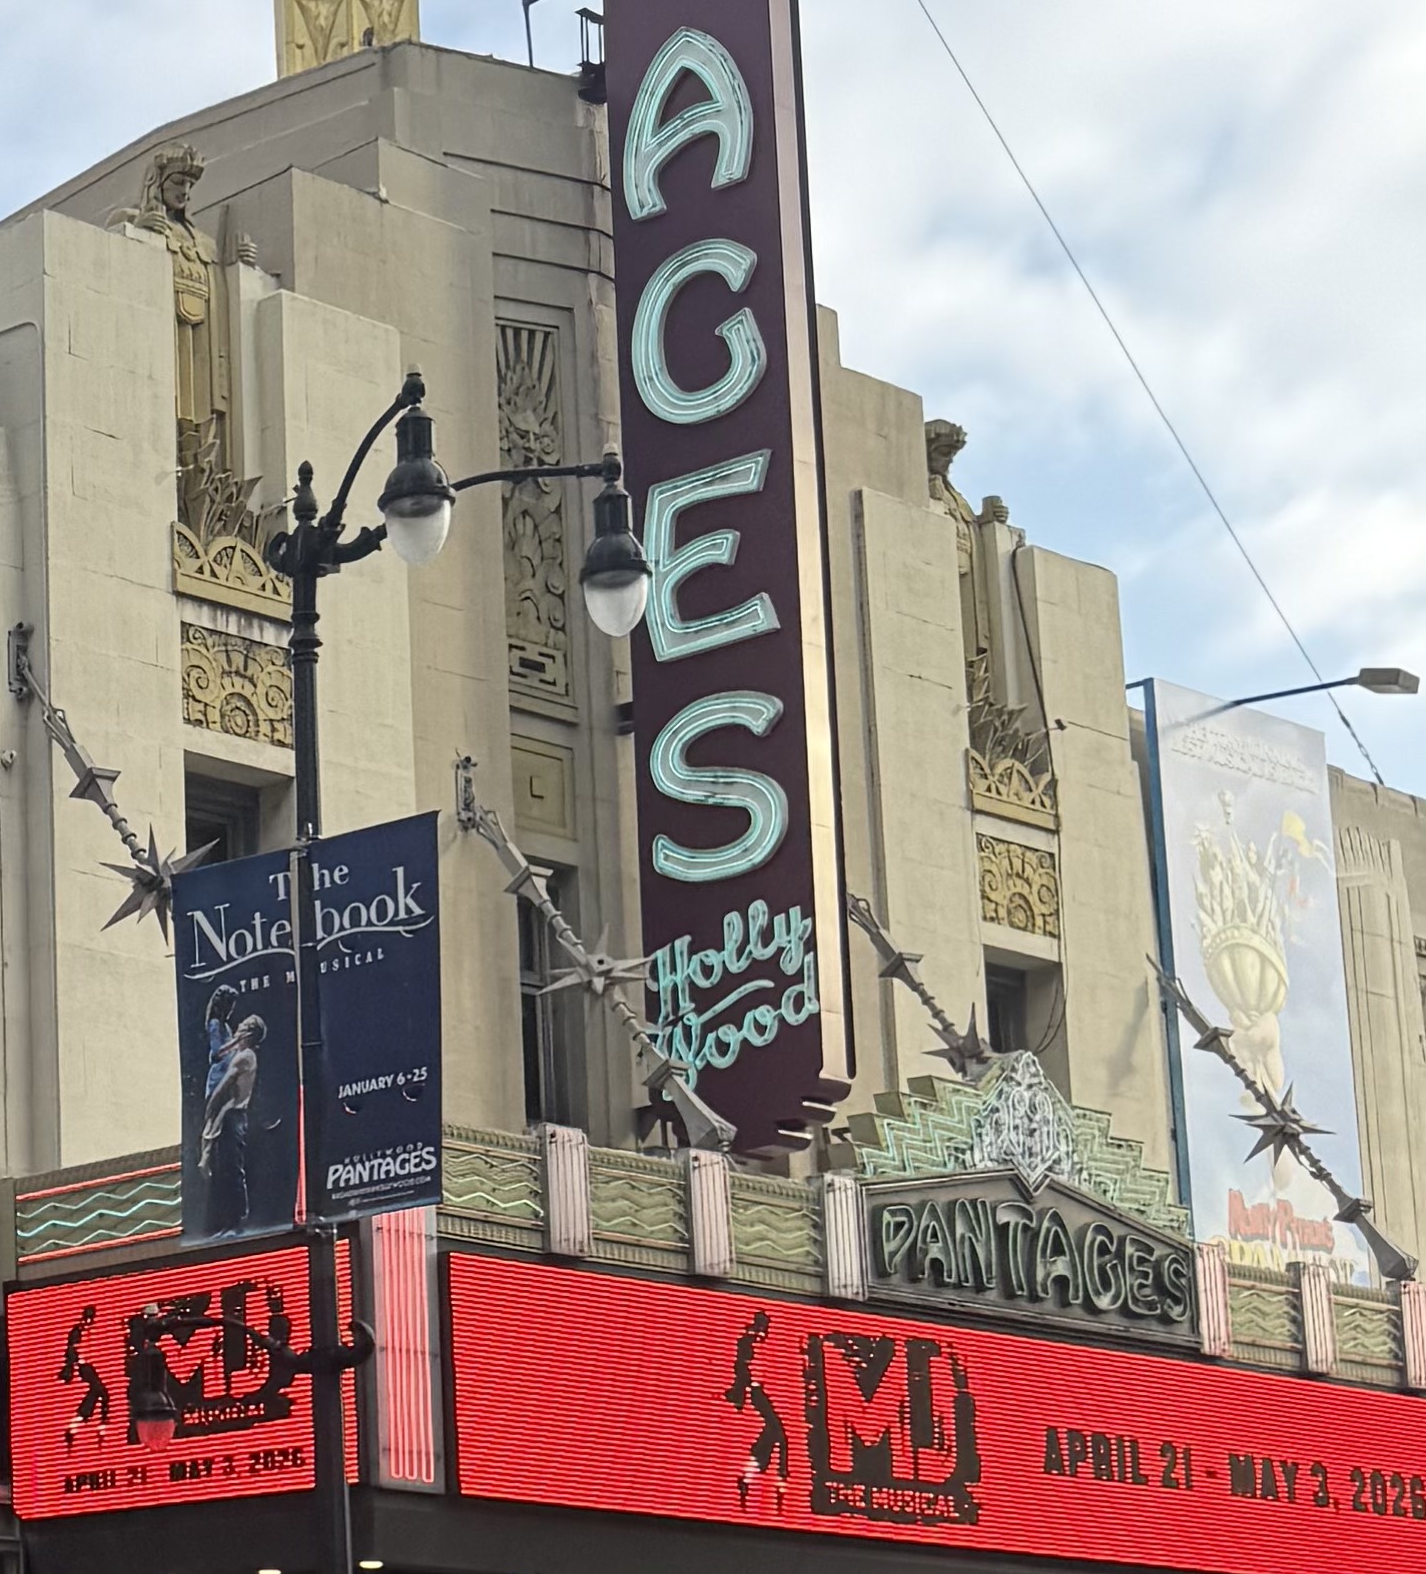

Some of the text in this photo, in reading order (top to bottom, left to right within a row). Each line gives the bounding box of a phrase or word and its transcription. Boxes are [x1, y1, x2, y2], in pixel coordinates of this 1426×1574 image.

[269, 863, 349, 901] The
[186, 867, 427, 969] Notebook
[240, 975, 270, 993] THE
[647, 899, 812, 1027] Holly
[338, 1074, 394, 1098] JANUARY
[327, 1147, 437, 1189] PANTAGES
[882, 1198, 1190, 1322] PANTAGES
[822, 1337, 958, 1484] MJ
[825, 1480, 958, 1517] THE MUSICAL
[1044, 1427, 1146, 1485] APRIL
[1159, 1441, 1193, 1491] 21
[1229, 1453, 1300, 1503] MAY
[1350, 1466, 1426, 1520] 2026
